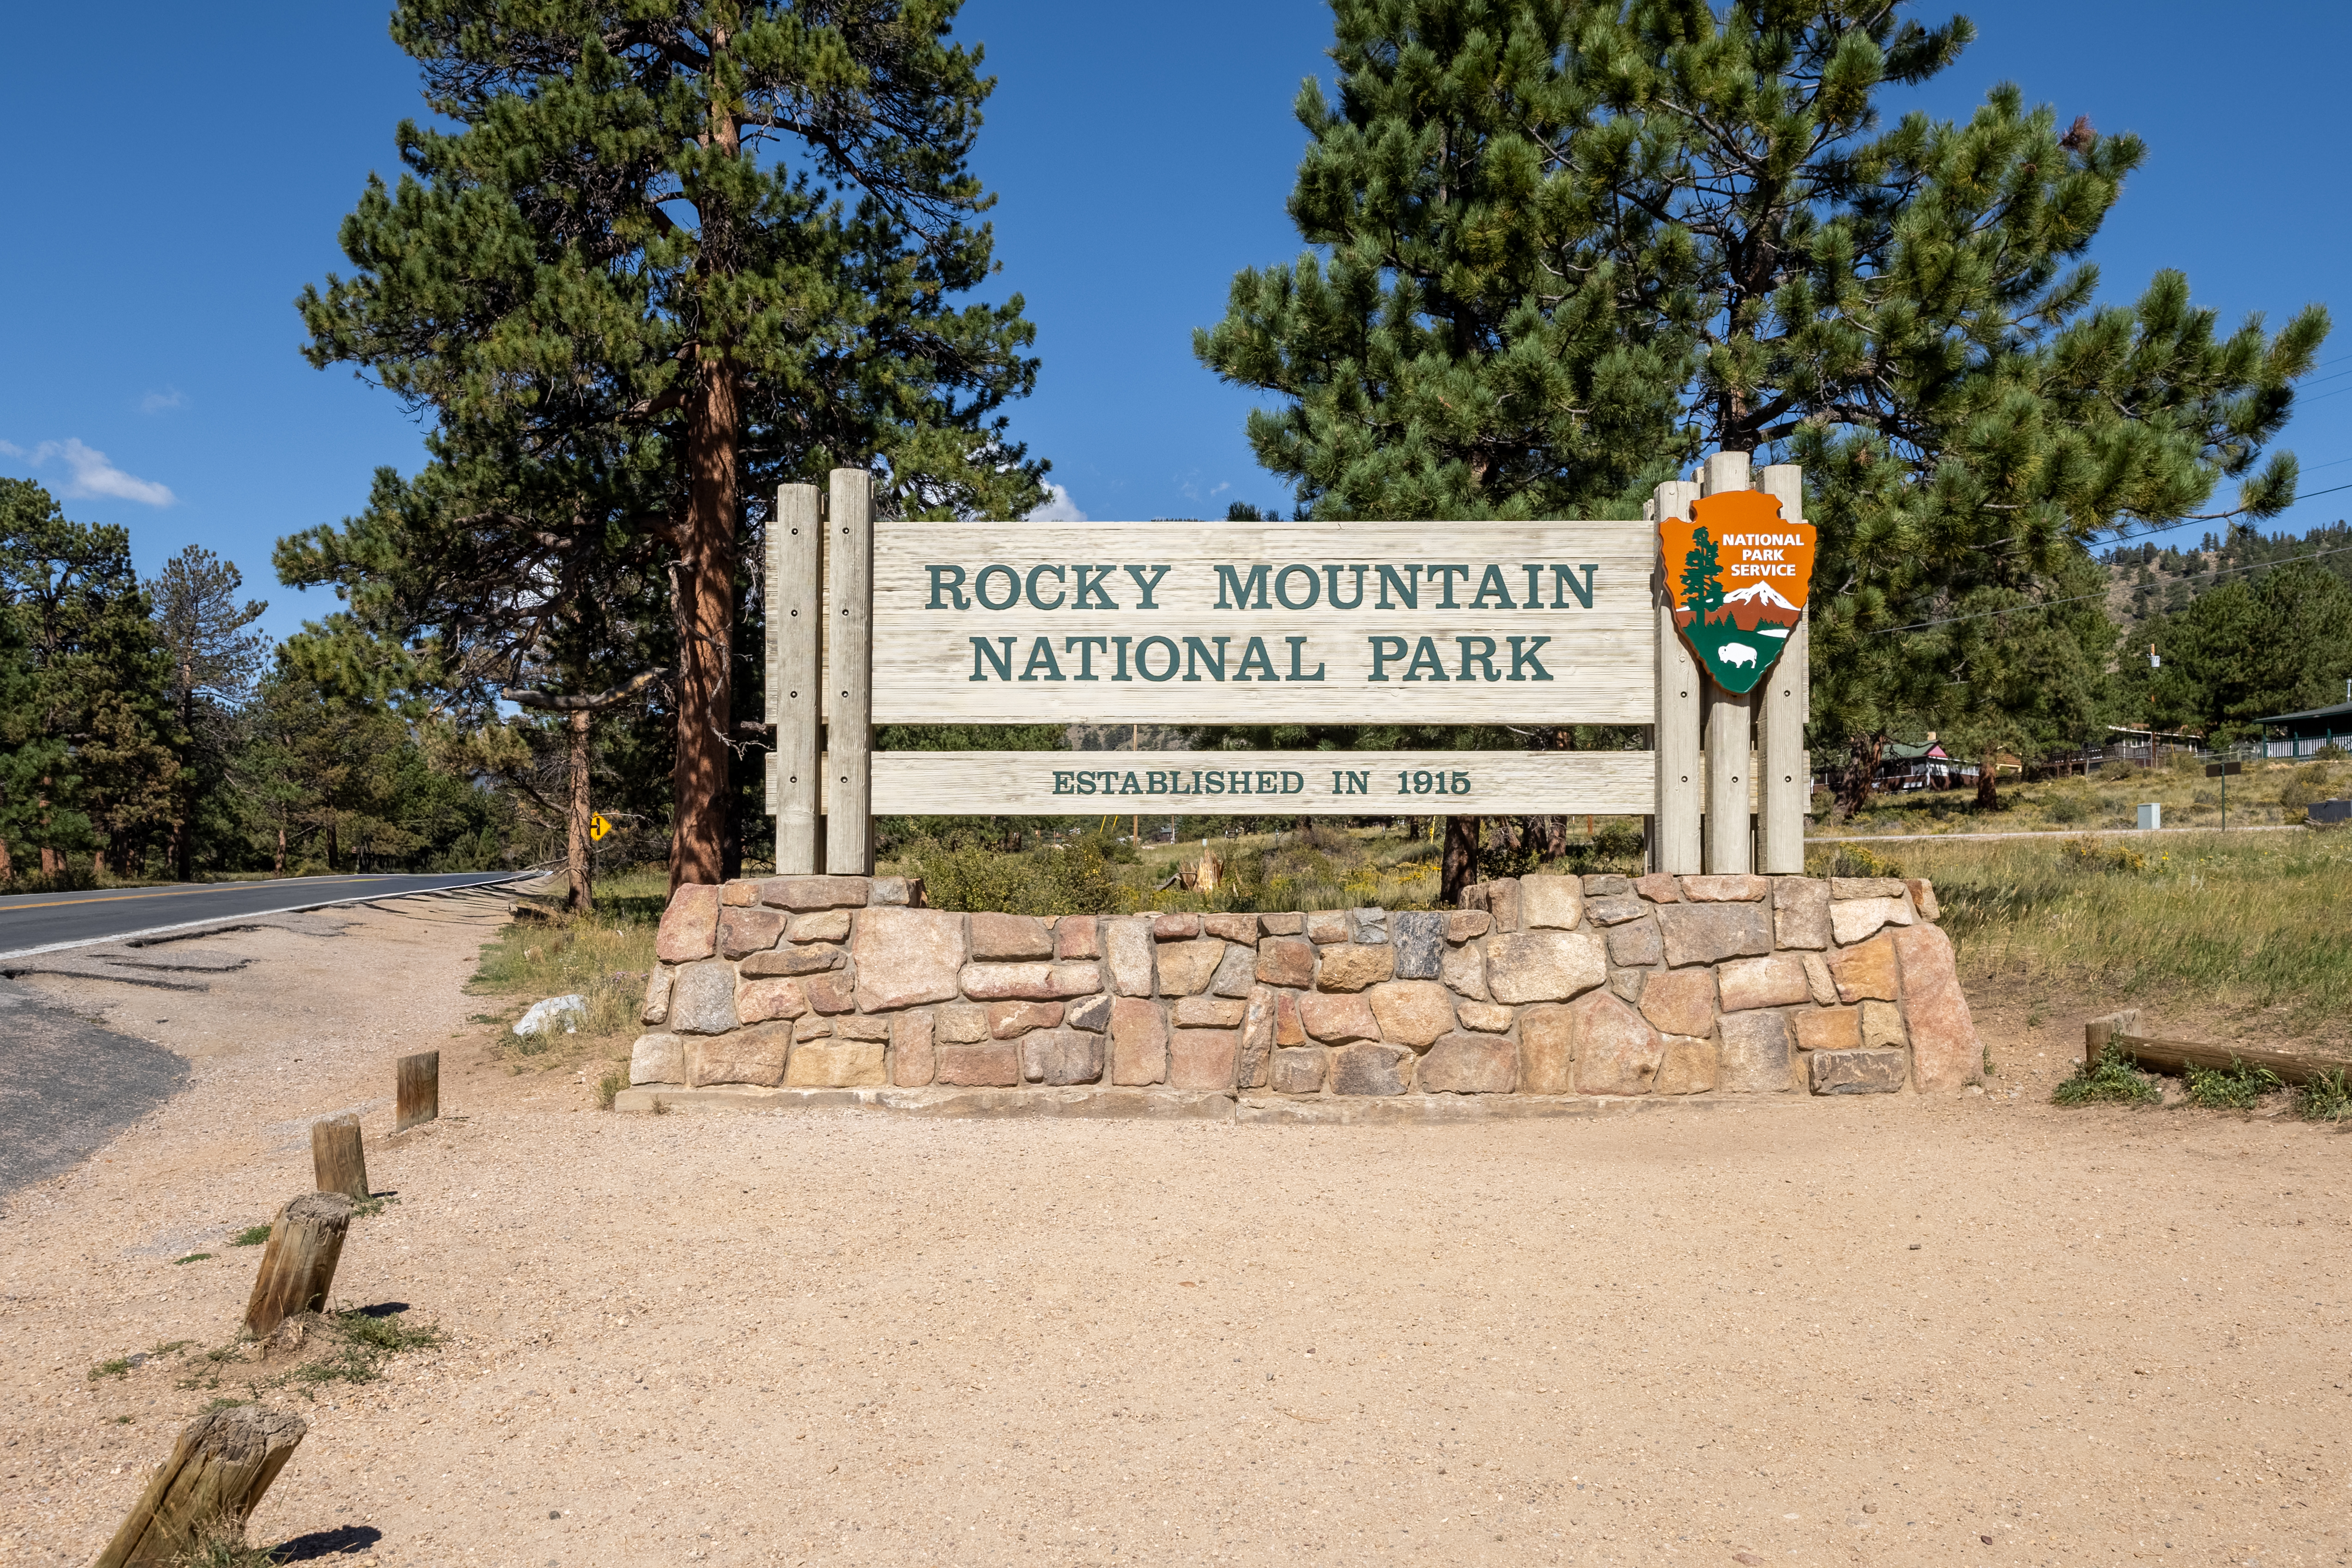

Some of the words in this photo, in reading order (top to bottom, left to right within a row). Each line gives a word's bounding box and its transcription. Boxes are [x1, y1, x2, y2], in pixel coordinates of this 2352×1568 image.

[1723, 534, 1804, 546] NATIONAL
[1742, 549, 1784, 561] PARK
[1731, 564, 1796, 576] SERVICE
[925, 564, 1171, 610] ROCKY
[1213, 564, 1599, 610] MOUNTAIN
[969, 636, 1325, 681] NATIONAL
[1368, 636, 1554, 681] PARK
[1053, 771, 1304, 794] ESTABLISHED
[1332, 771, 1370, 794] IN
[1398, 771, 1471, 794] 1915
